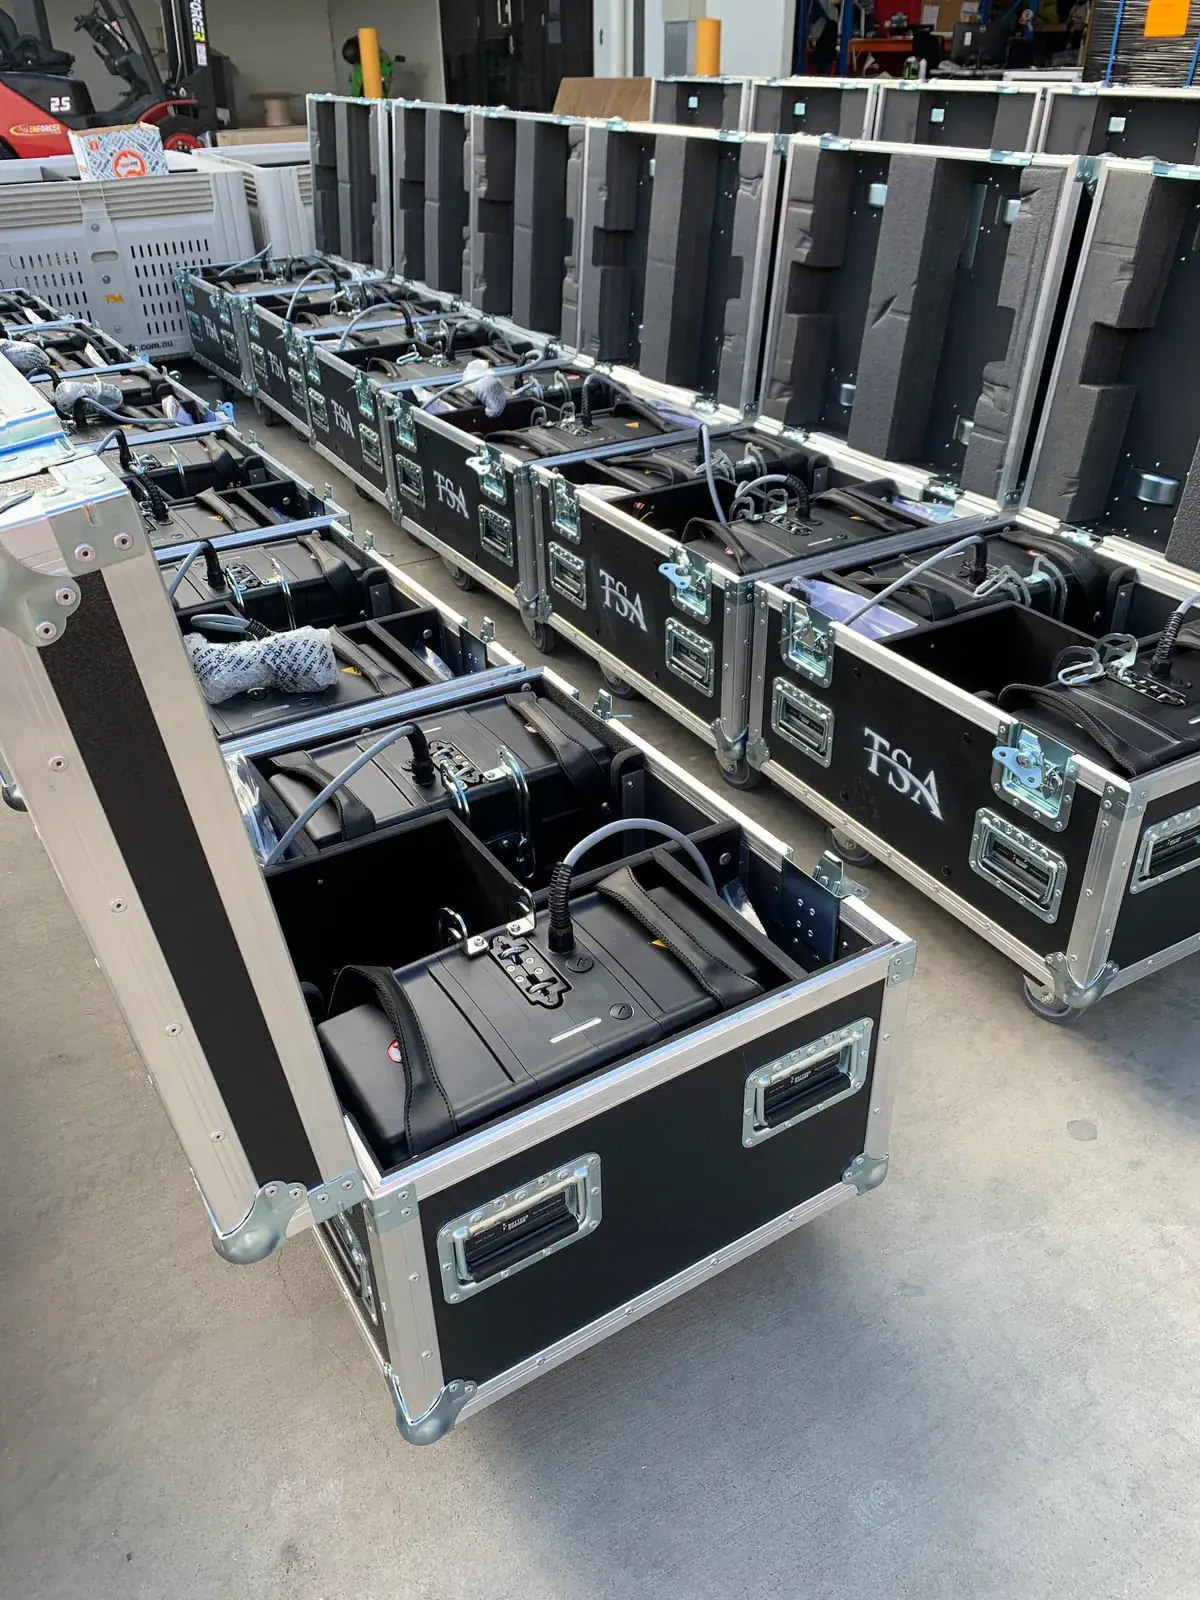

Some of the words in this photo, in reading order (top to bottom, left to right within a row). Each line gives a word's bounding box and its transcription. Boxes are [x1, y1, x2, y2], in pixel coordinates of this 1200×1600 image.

[202, 315, 220, 343] TSA
[267, 350, 286, 383] TSA
[331, 399, 355, 439] TSA
[433, 471, 470, 519] TSA
[599, 568, 648, 632] TSA
[862, 727, 944, 822] TSA
